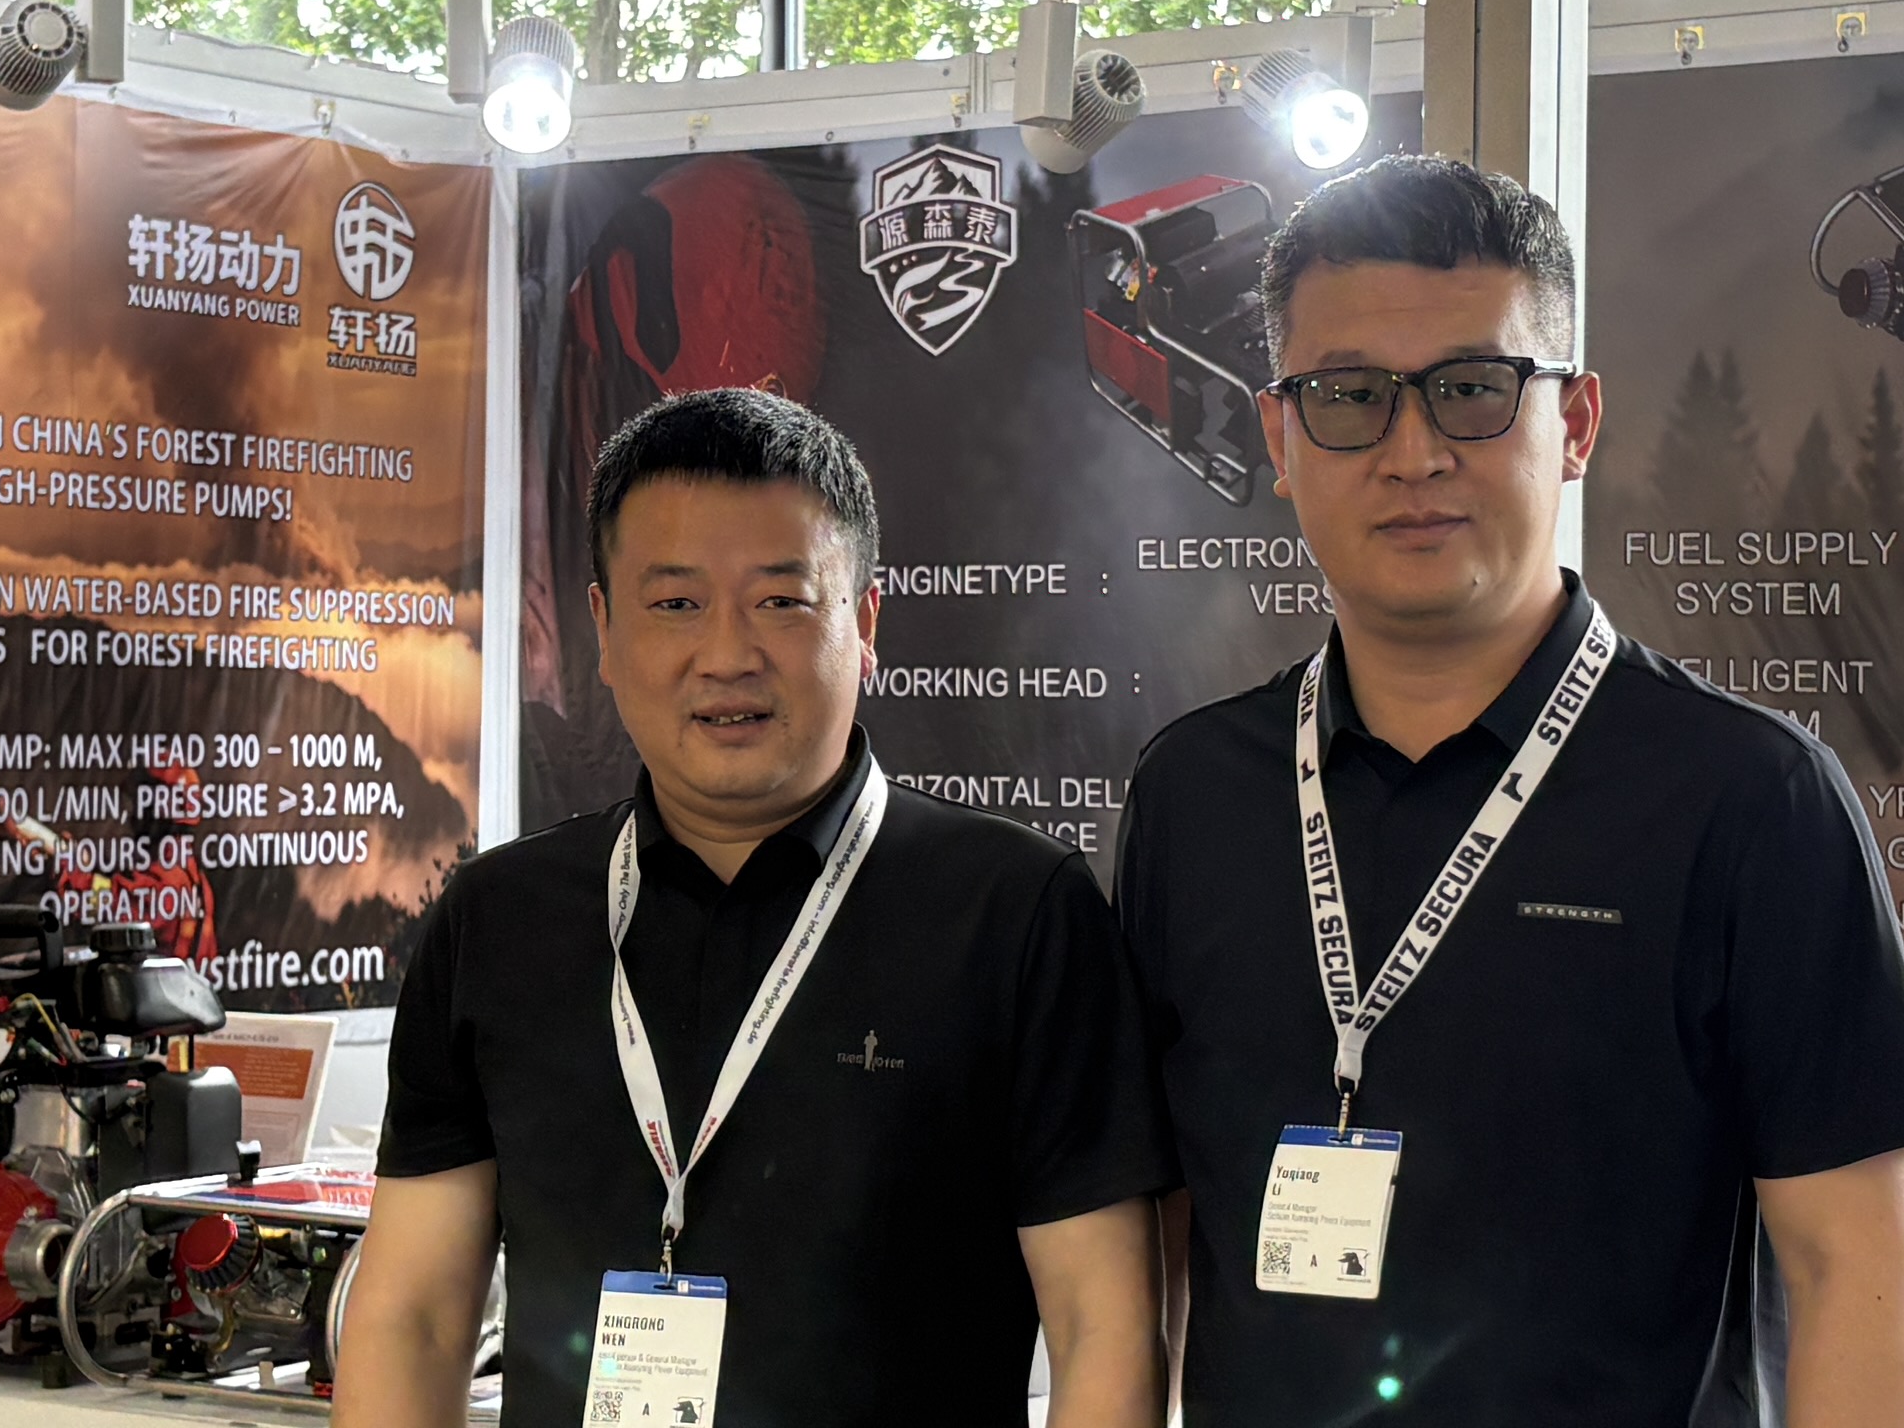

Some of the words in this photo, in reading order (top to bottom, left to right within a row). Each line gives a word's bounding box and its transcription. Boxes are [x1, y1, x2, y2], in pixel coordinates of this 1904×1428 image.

[128, 213, 302, 296] 轩扬动力
[128, 283, 229, 318] XUANYANG
[234, 298, 300, 326] POWER
[327, 306, 416, 358] 轩扬
[13, 414, 127, 461] CHINA'S
[137, 427, 235, 468] FOREST
[243, 435, 413, 482] FIREFIGHTING
[194, 478, 293, 522] PUMPS!
[1625, 532, 1725, 566] FUEL
[1737, 531, 1897, 565] SUPPLY
[874, 564, 1067, 595] ENGINETYPE
[1676, 582, 1841, 616] SYSTEM
[24, 577, 221, 620] WATER-BASED
[230, 584, 281, 620] FIRE
[289, 586, 454, 627] SUPPRESSION
[31, 628, 88, 666] FOR
[96, 630, 198, 669] FOREST
[205, 632, 378, 672] FIREFIGHTING
[863, 667, 1008, 697] WORKING
[1019, 668, 1106, 697] HEAD
[1538, 655, 1600, 746] STEITZ
[213, 733, 260, 769] 300
[290, 733, 347, 768] 1000
[353, 733, 382, 773] M,
[37, 786, 129, 827] L/MIN,
[138, 783, 268, 820] PRESSURE
[343, 780, 404, 820] MPA,
[54, 835, 151, 874] HOURS
[159, 833, 194, 870] OF
[201, 830, 369, 869] CONTINUOUS
[1306, 811, 1339, 909] STEITZ
[1355, 938, 1428, 1032] STEITZ
[1415, 831, 1498, 937] SECURA
[1318, 915, 1354, 1026] SECURA
[602, 1333, 626, 1346] WEN
